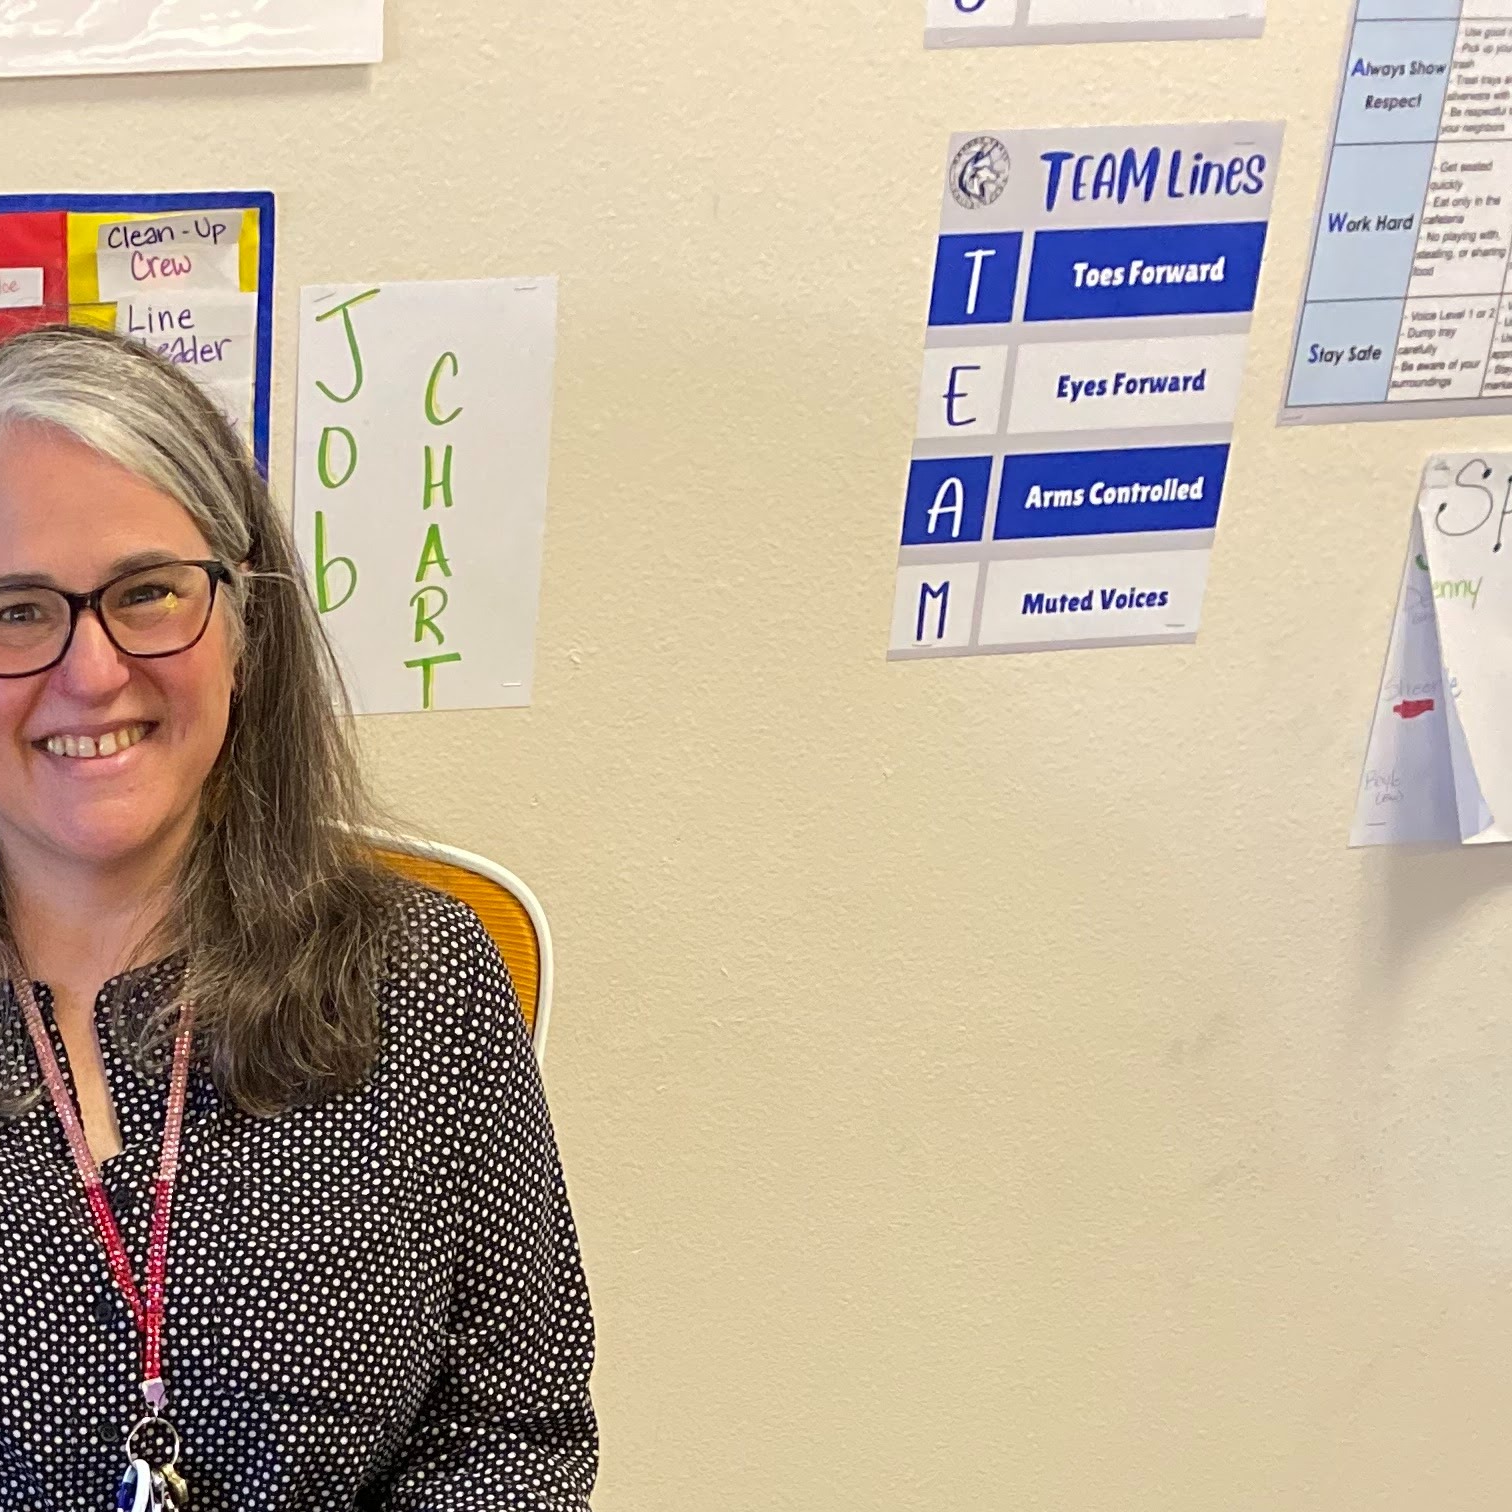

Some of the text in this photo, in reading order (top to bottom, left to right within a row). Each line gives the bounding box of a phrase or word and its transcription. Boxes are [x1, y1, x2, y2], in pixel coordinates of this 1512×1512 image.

[1350, 58, 1447, 79] Always Show
[1365, 94, 1422, 111] Respect
[1040, 147, 1160, 211] TEAM
[1168, 149, 1266, 199] Lines
[1328, 212, 1414, 234] Work Hard
[131, 250, 192, 281] Crew
[1073, 256, 1224, 288] Toes Forward
[963, 249, 996, 316] T
[129, 304, 195, 334] Line
[141, 335, 232, 366] eader
[1307, 342, 1382, 366] Stay Safe
[943, 365, 981, 426] E
[1057, 369, 1206, 402] Eyes Forward
[927, 477, 964, 538] A
[1025, 476, 1204, 510] Arms Controlled
[403, 351, 463, 710] CHART
[916, 581, 950, 641] M
[1021, 588, 1168, 615] Muted Voices
